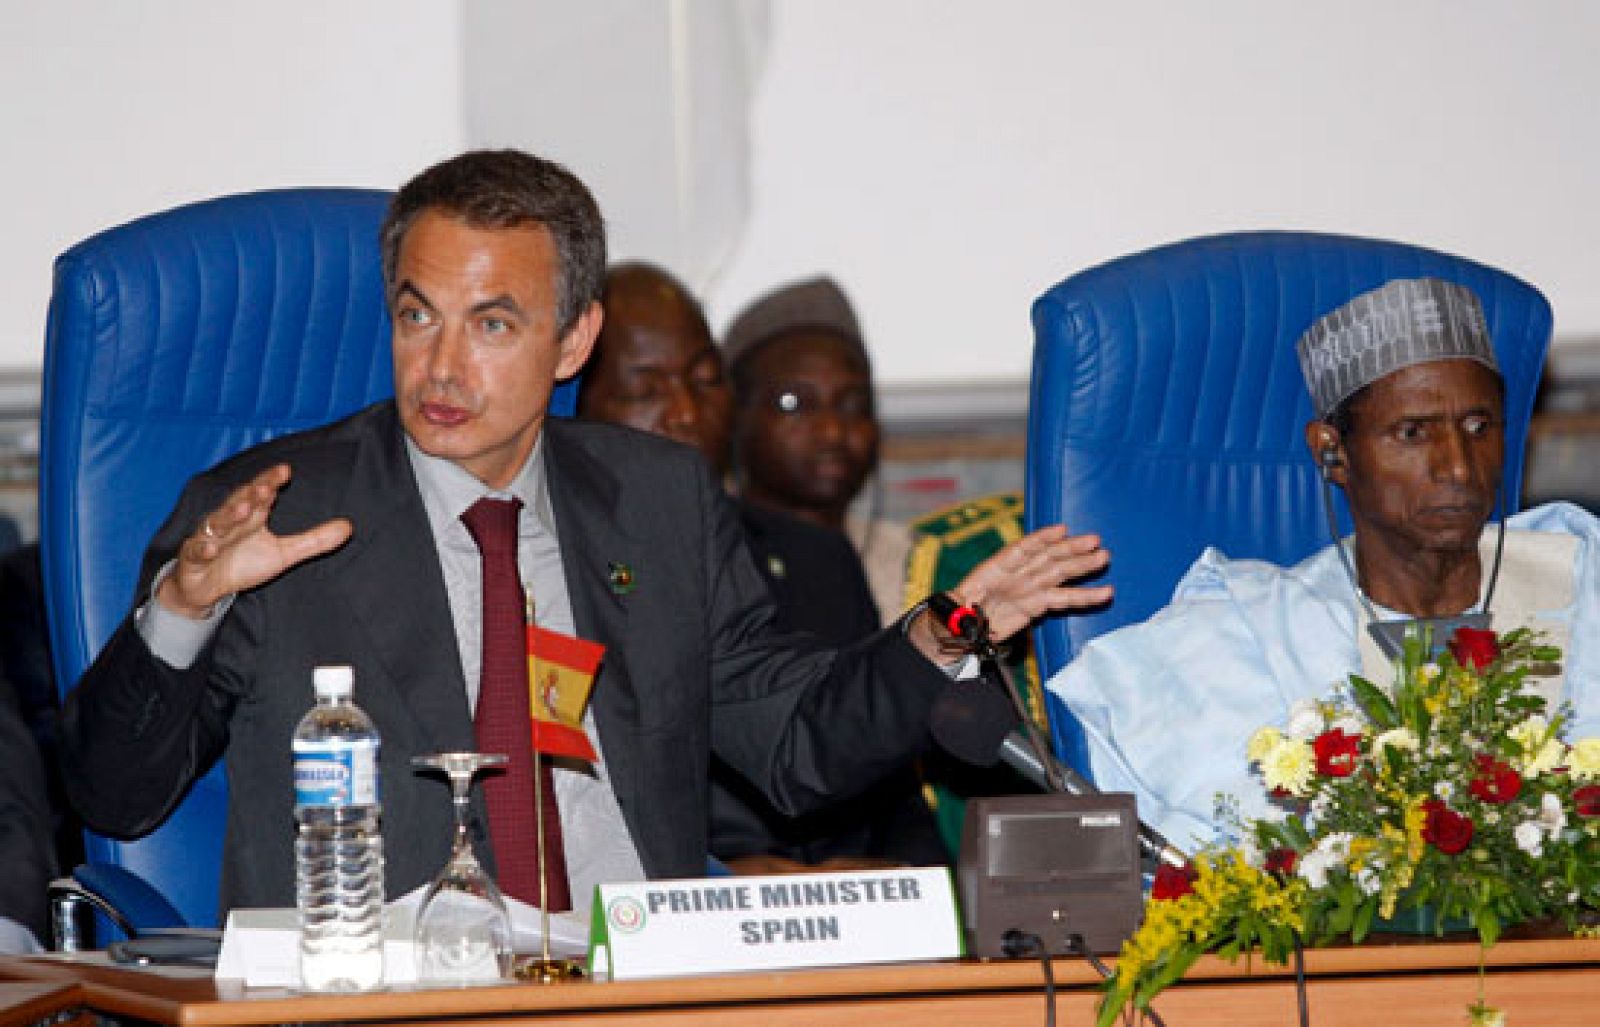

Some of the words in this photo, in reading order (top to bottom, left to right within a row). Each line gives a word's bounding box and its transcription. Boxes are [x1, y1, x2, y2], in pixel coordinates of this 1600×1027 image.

[648, 888, 753, 914] PRIME
[760, 877, 921, 908] MINISTER
[741, 917, 839, 943] SPAIN
